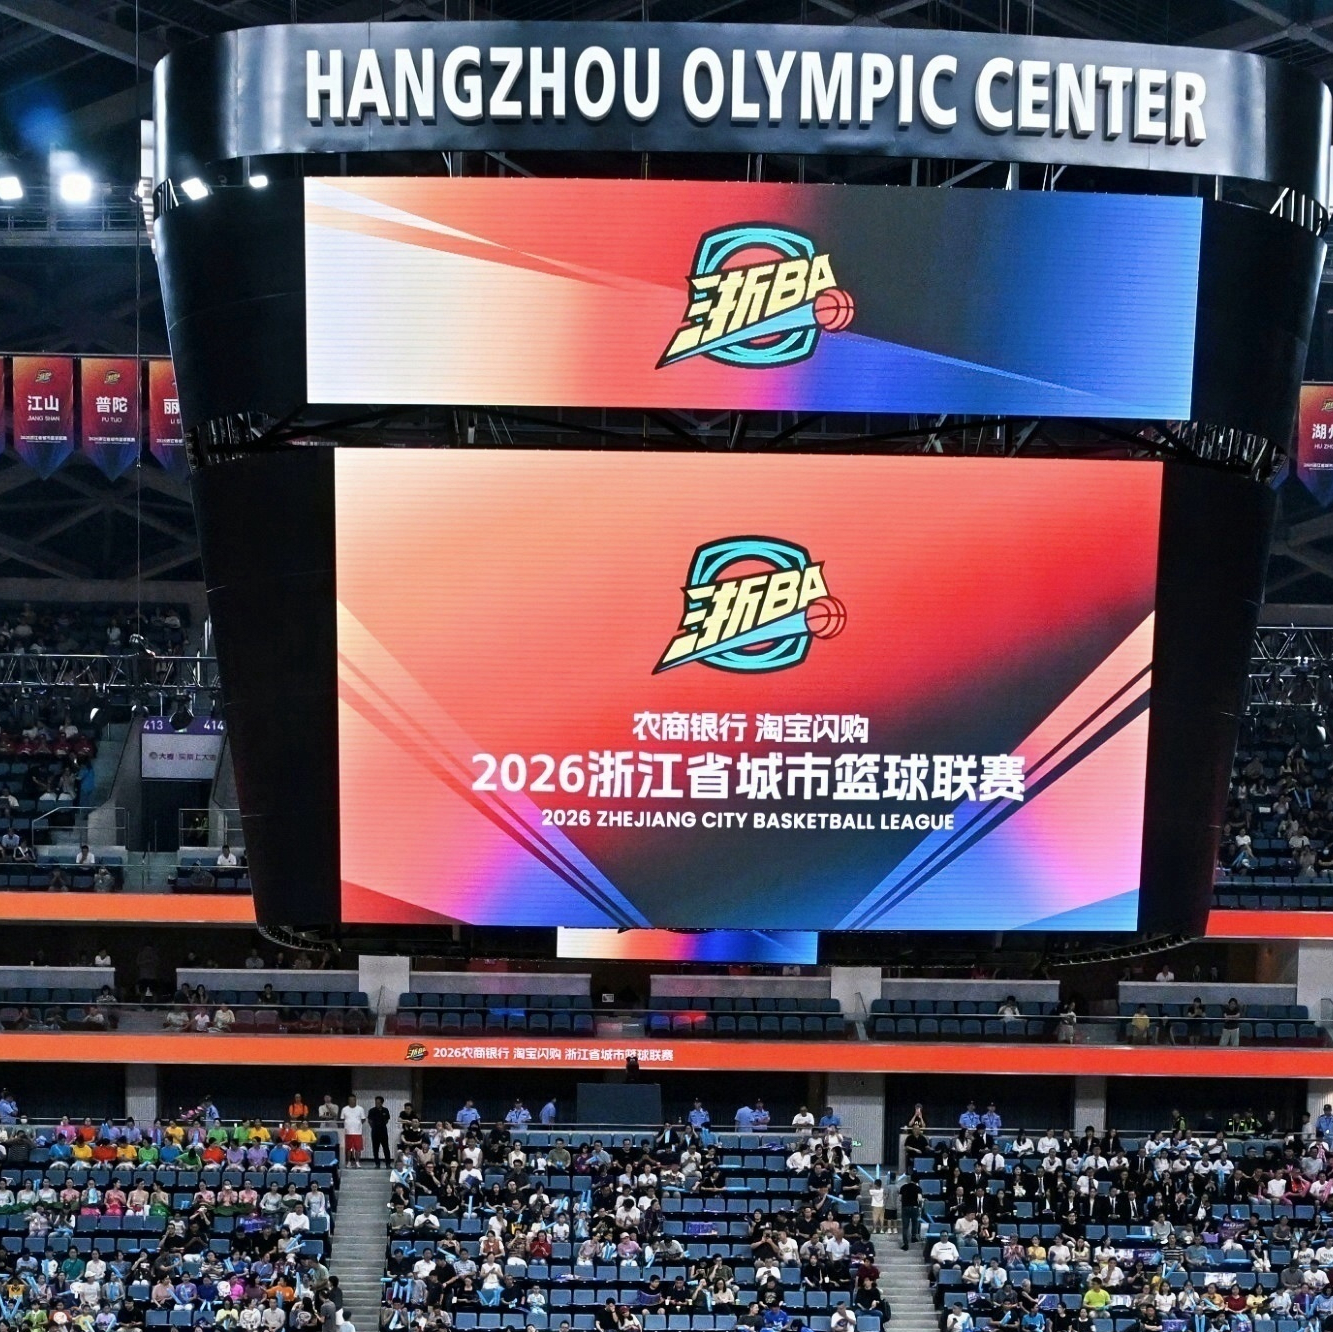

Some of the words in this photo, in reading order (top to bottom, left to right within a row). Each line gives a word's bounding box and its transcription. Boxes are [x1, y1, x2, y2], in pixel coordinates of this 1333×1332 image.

[305, 46, 661, 123] HANGZHOU
[683, 48, 957, 130] OLYMPIC
[976, 56, 1207, 145] CENTER
[667, 254, 839, 354] 浙BA
[27, 395, 59, 412] 江山
[95, 396, 128, 413] 普陀
[662, 562, 829, 662] 浙BA
[143, 720, 163, 731] 413
[204, 720, 224, 731] 414
[632, 712, 747, 743] 农商银行
[755, 713, 870, 744] 淘宝闪购
[471, 750, 1027, 803] 2026浙江省城市篮球联赛
[541, 808, 591, 828] 2026
[597, 809, 698, 829] ZHEJIANG
[703, 811, 748, 829] CITY
[753, 811, 875, 831] BASKETBALL
[880, 813, 954, 832] LEAGUE
[433, 1046, 509, 1058] 2026农商银行
[513, 1047, 562, 1060] 淘宝闪购
